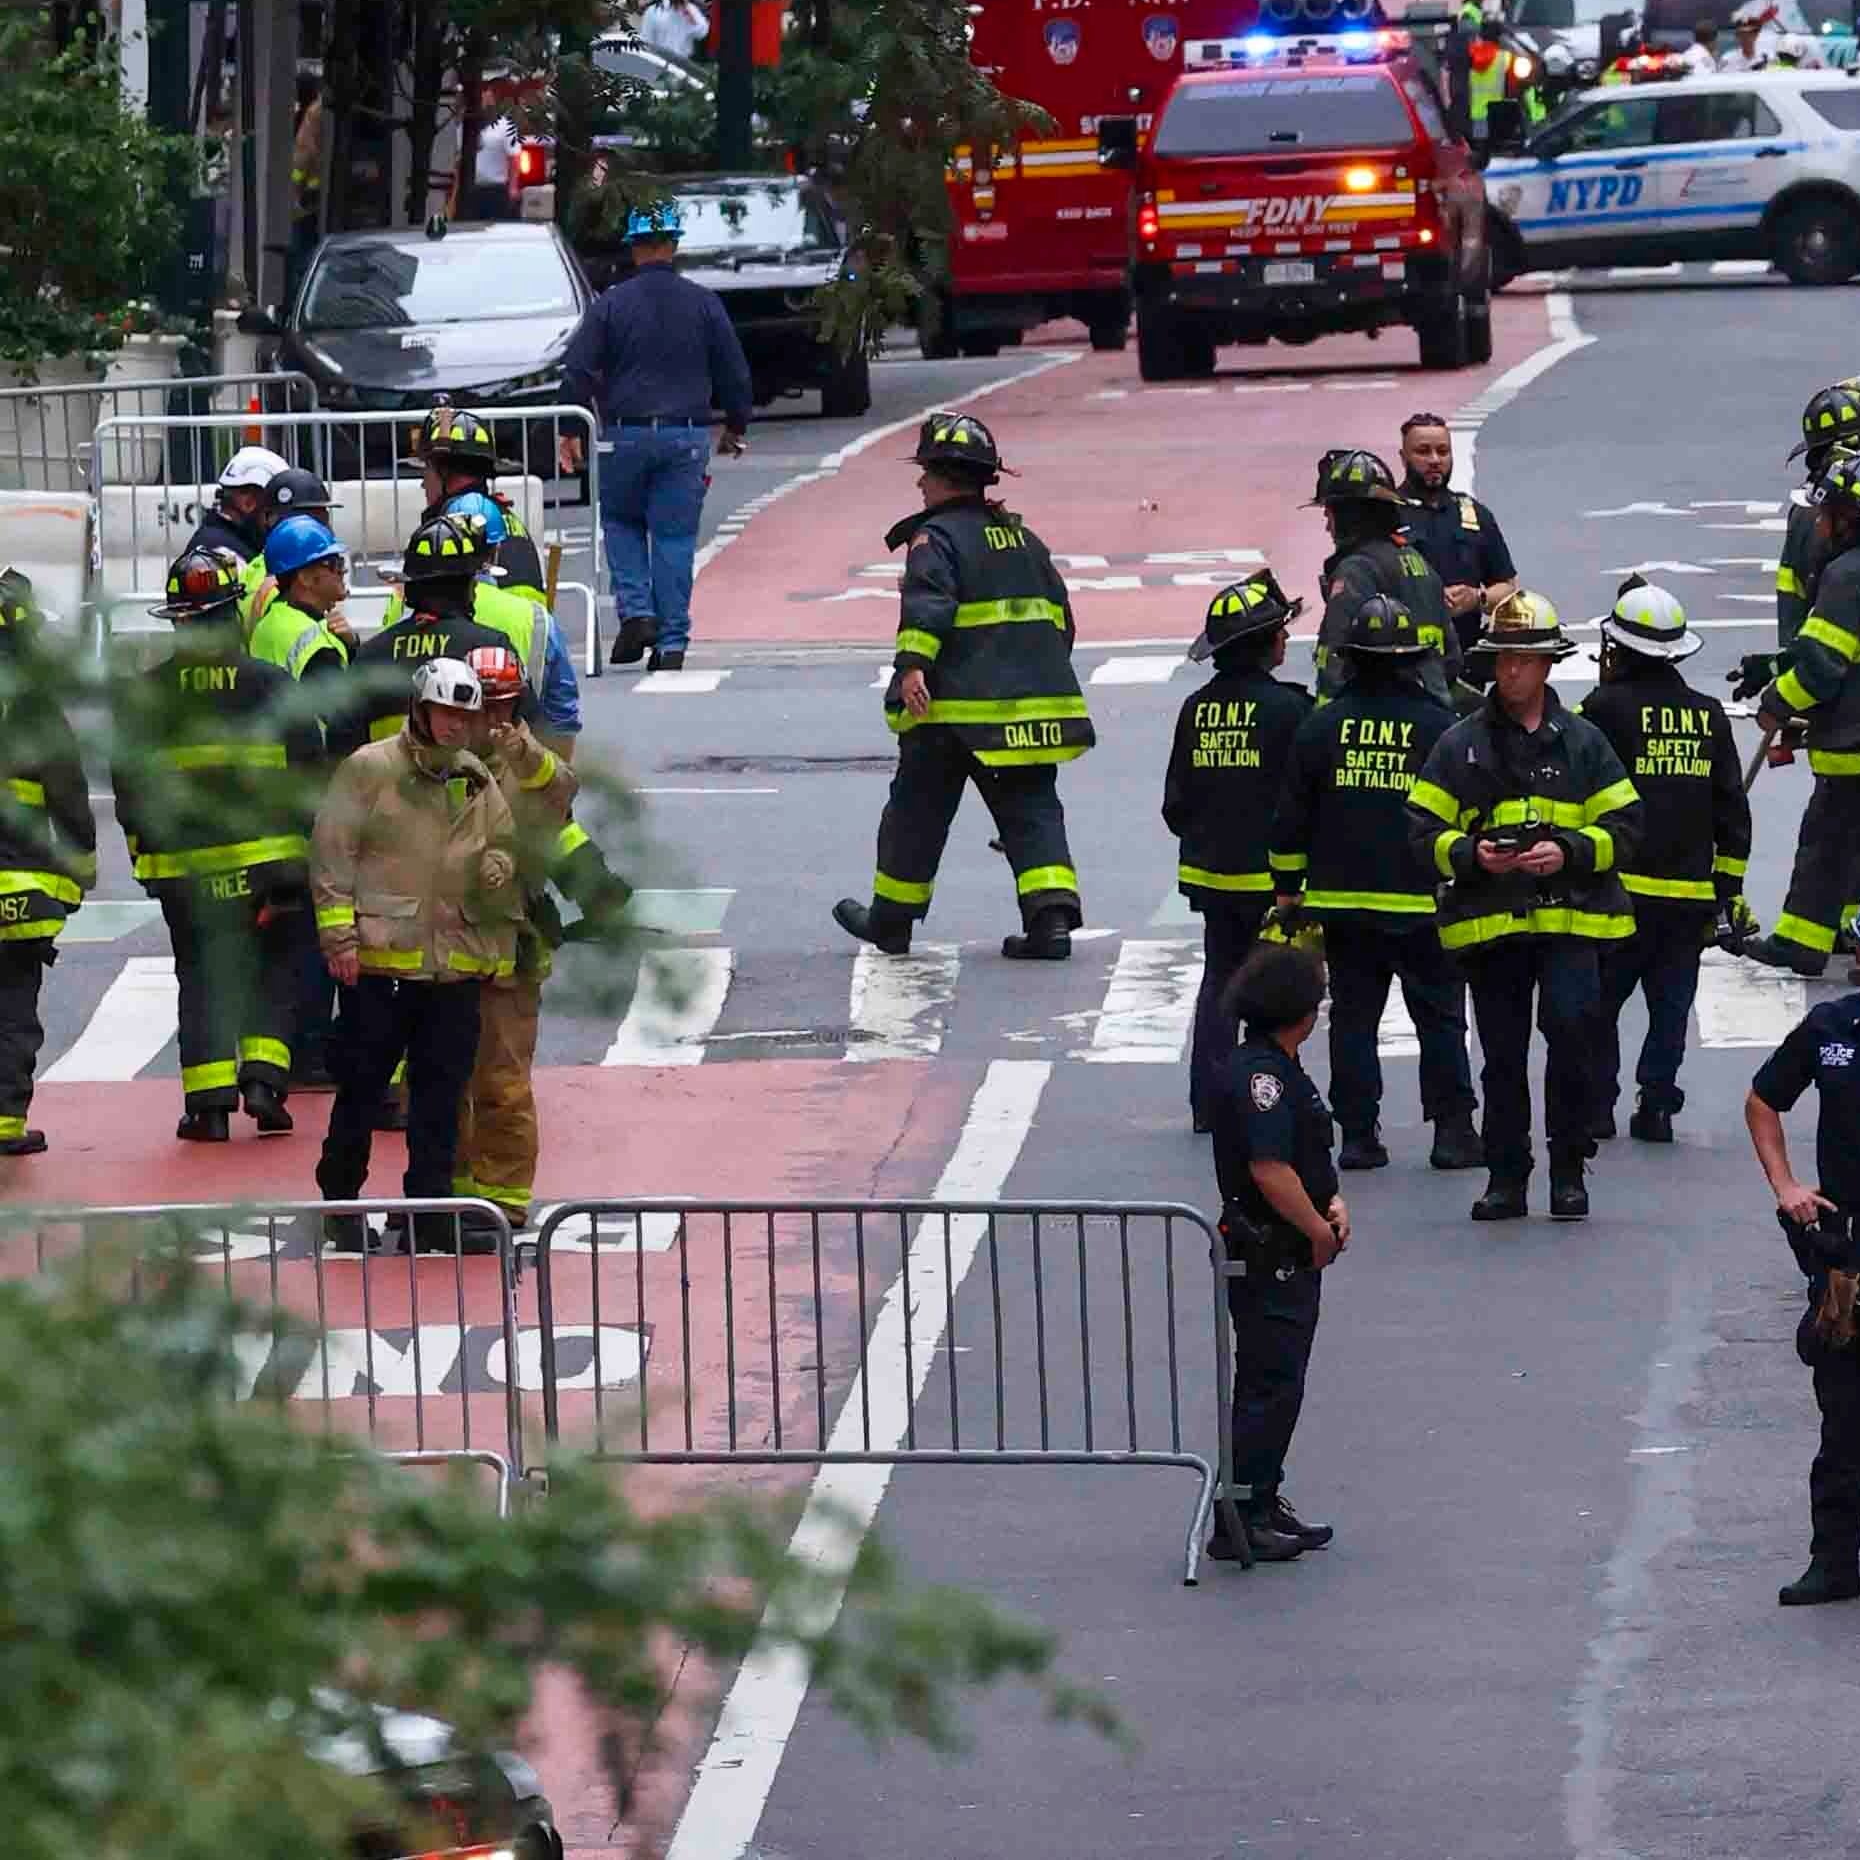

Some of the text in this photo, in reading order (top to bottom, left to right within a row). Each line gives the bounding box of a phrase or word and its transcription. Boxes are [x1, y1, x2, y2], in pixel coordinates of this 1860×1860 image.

[1547, 174, 1643, 213] NYPD
[1244, 194, 1336, 225] FDNY
[392, 633, 452, 659] FDNY
[179, 665, 240, 691] FDNY
[1199, 730, 1249, 749] SAFETY
[1646, 738, 1701, 758] SAFETY
[1192, 749, 1261, 769] BATTALION
[1345, 750, 1408, 771] SAFETY
[1634, 757, 1712, 778] BATTALION
[1335, 768, 1417, 793] BATTALION
[1819, 1047, 1855, 1059] POLICE
